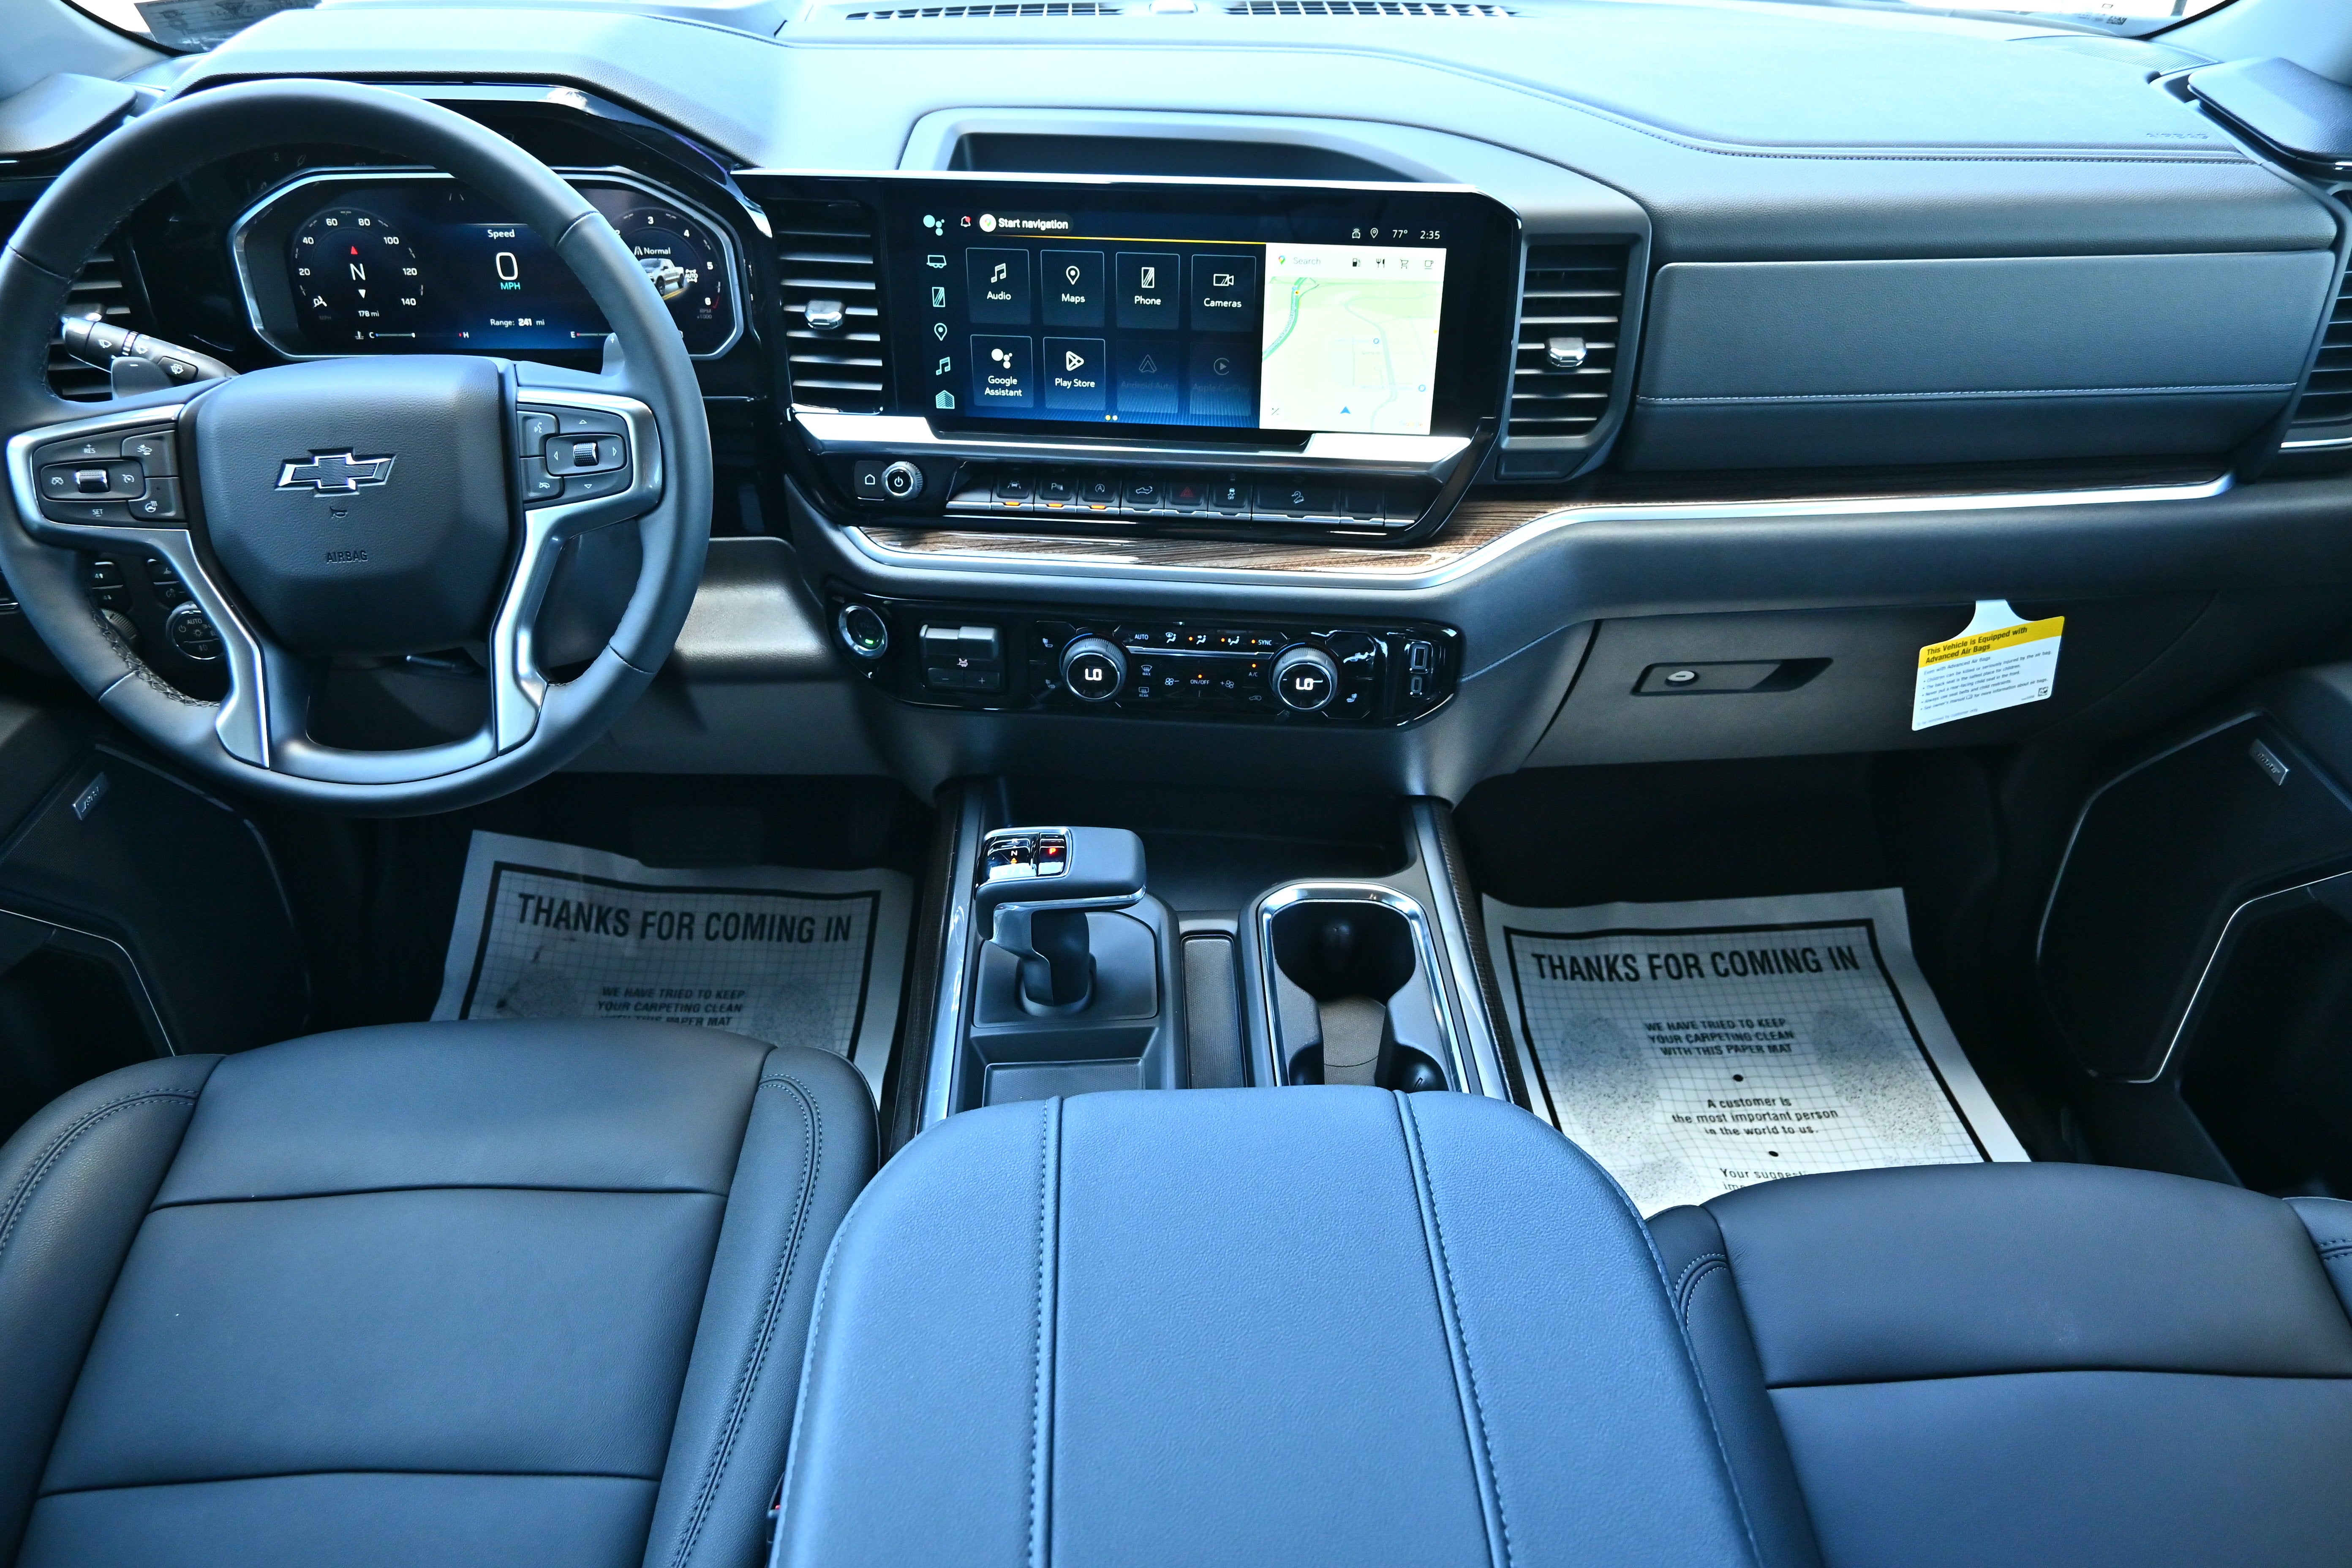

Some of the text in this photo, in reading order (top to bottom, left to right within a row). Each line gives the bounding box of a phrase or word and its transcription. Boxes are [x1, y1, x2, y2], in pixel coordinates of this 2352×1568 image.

[326, 218, 338, 226] 60
[358, 218, 370, 226] 80
[648, 216, 654, 224] 3
[999, 218, 1068, 231] Start navigation
[487, 229, 515, 240] Speed
[683, 229, 690, 237] 4
[1393, 230, 1407, 238] 77°
[1420, 231, 1440, 240] 2:35
[384, 237, 399, 245] 100
[496, 252, 518, 280] 0
[707, 261, 713, 270] 5
[1293, 257, 1321, 265] Search
[299, 268, 310, 276] 20
[350, 263, 366, 280] N
[403, 268, 417, 276] 120
[500, 282, 521, 290] MPH
[987, 291, 1011, 300] Audio
[1062, 294, 1085, 304] Maps
[1135, 296, 1161, 305] Phone
[705, 297, 711, 305] 6
[1204, 298, 1242, 308] Cameras
[490, 318, 514, 328] Range:
[518, 318, 532, 327] 241
[988, 376, 1018, 387] Google
[1055, 378, 1095, 388] Play Store
[985, 387, 1022, 397] Assistant
[327, 550, 368, 564] AIRBAG
[1927, 646, 1941, 654] This
[1943, 640, 1968, 651] Vehicle
[1978, 630, 2010, 643] Equipped
[2012, 626, 2028, 635] with
[1925, 650, 1959, 663] Advanced
[1973, 642, 1991, 653] Bags
[1947, 660, 1970, 669] Advanced
[518, 893, 851, 943] THANKS FOR COMING IN
[1532, 946, 1860, 982] THANKS FOR COMING IN
[602, 986, 745, 999] WE HAVE TRIED TO KEEP
[597, 1000, 742, 1013] YOUR CARPETING CLEAN
[708, 1017, 733, 1026] MAT
[1645, 1018, 1786, 1031] WE HAVE TRIED TO KEEP
[1649, 1031, 1794, 1044] YOUR CARPETING CLEAN
[1660, 1043, 1792, 1056] WITH THIS PAPER MAT
[1708, 1097, 1792, 1109] A customer is
[1672, 1109, 1838, 1124] the most important person
[1705, 1125, 1818, 1135] in the world to us.
[1720, 1168, 1749, 1178] Your
